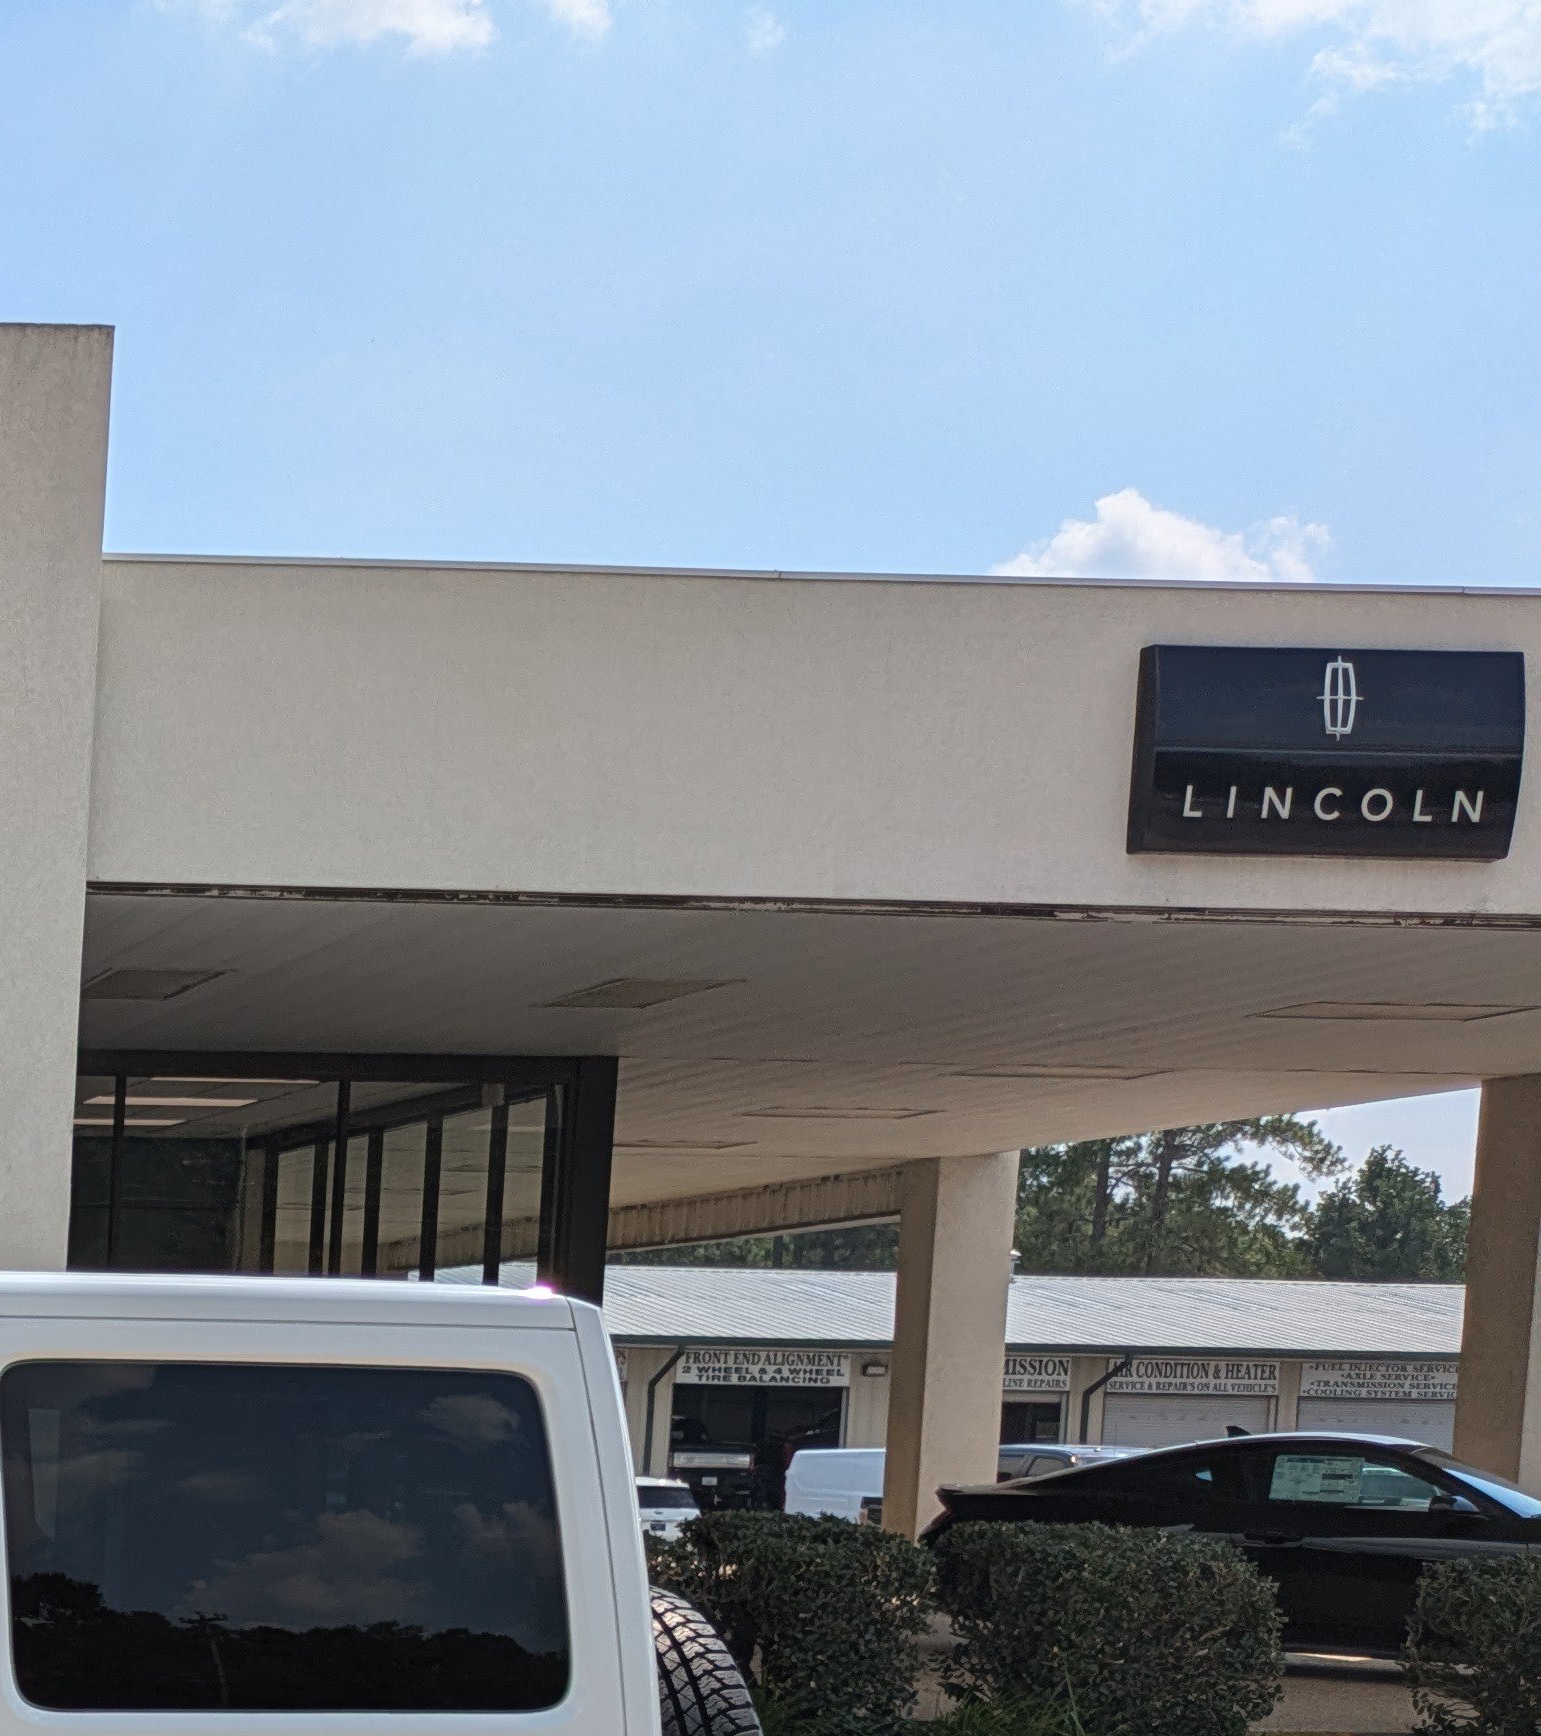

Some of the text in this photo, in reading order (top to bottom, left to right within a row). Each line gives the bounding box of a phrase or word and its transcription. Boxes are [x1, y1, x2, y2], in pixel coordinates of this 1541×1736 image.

[1182, 785, 1485, 823] LINCOLN
[685, 1351, 731, 1365] FRONT
[733, 1352, 762, 1365] END
[681, 1365, 692, 1374] 2
[697, 1366, 753, 1375] WHEEL
[772, 1367, 783, 1375] 4
[788, 1368, 845, 1376] WHEEL
[1136, 1361, 1210, 1379] CONDITION
[1213, 1363, 1221, 1379] &
[1224, 1363, 1277, 1380] HEATER
[696, 1374, 831, 1384] TIRE BALANCING
[1026, 1379, 1067, 1389] REPAIRS
[1109, 1380, 1146, 1391] SERVICE
[1197, 1382, 1211, 1391] ON
[1212, 1382, 1228, 1392] ALL
[1416, 1391, 1457, 1399] SERVIC
